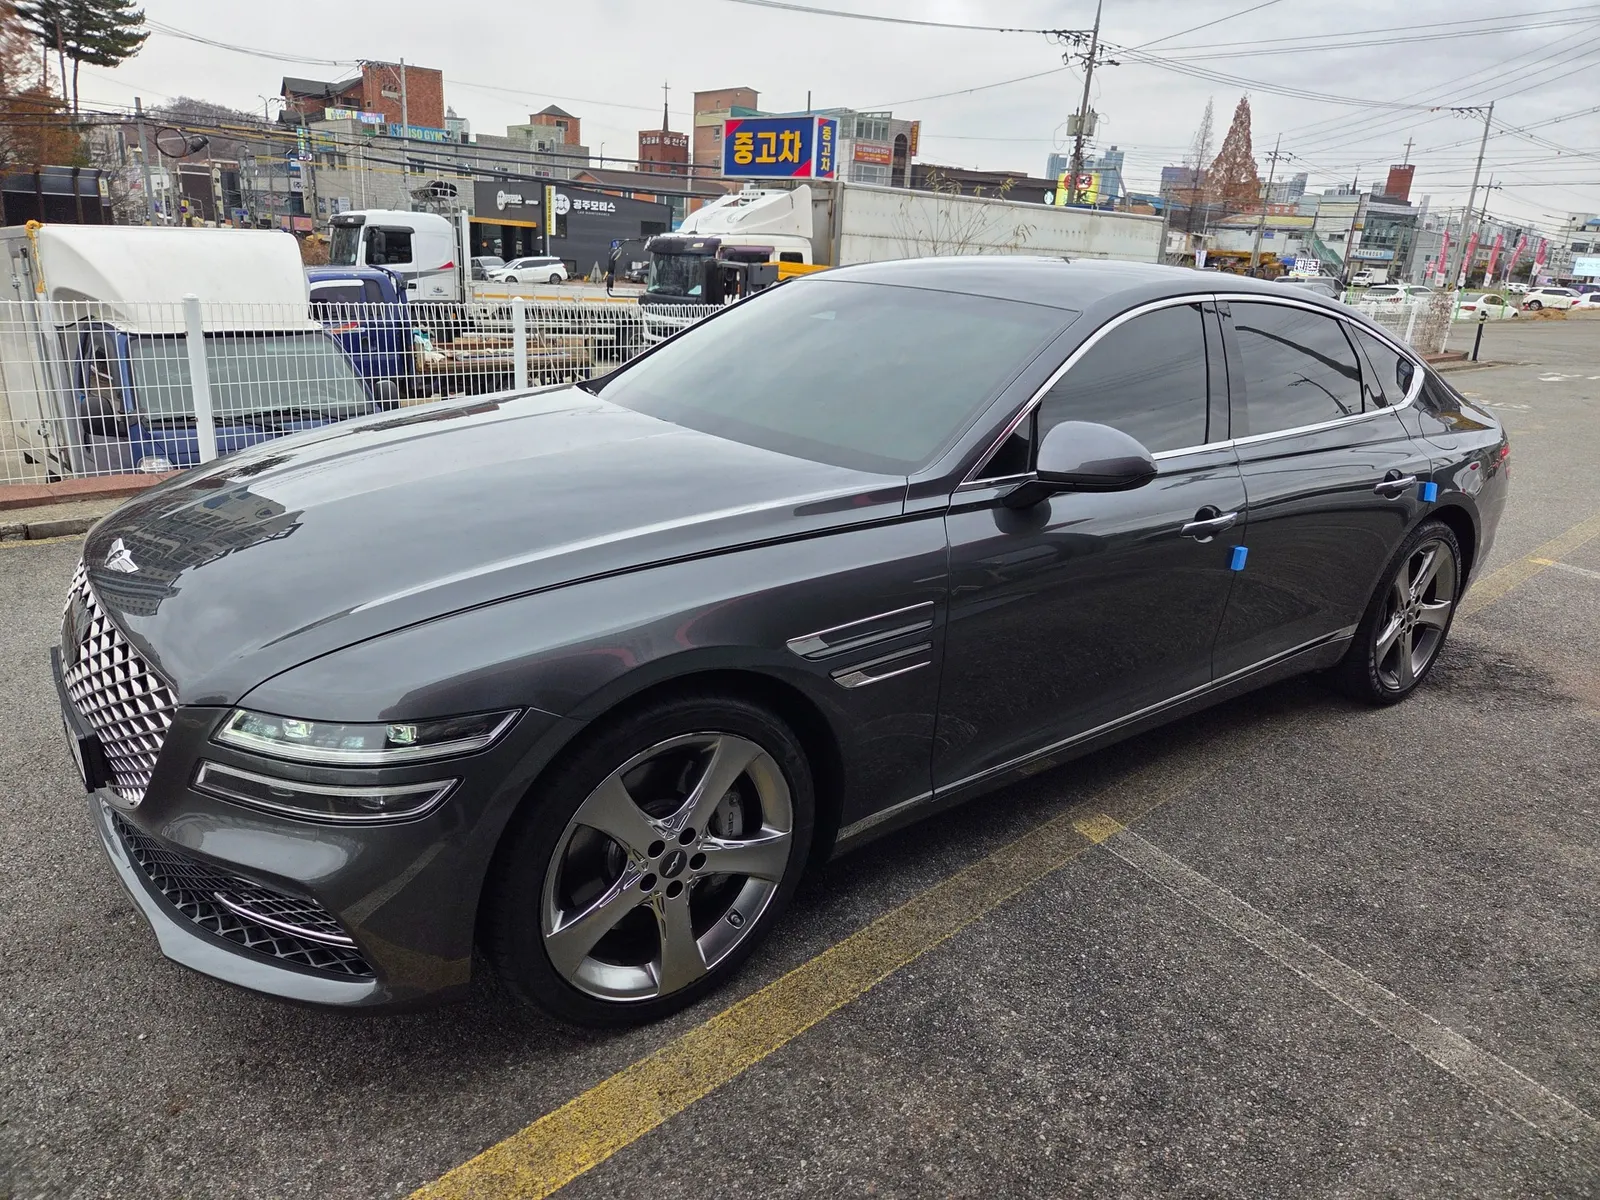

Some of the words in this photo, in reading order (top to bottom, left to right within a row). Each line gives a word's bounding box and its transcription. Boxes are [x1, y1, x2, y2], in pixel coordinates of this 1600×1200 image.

[733, 130, 802, 165] 중고차
[820, 126, 832, 172] 중고차
[573, 199, 616, 213] 공주모터스
